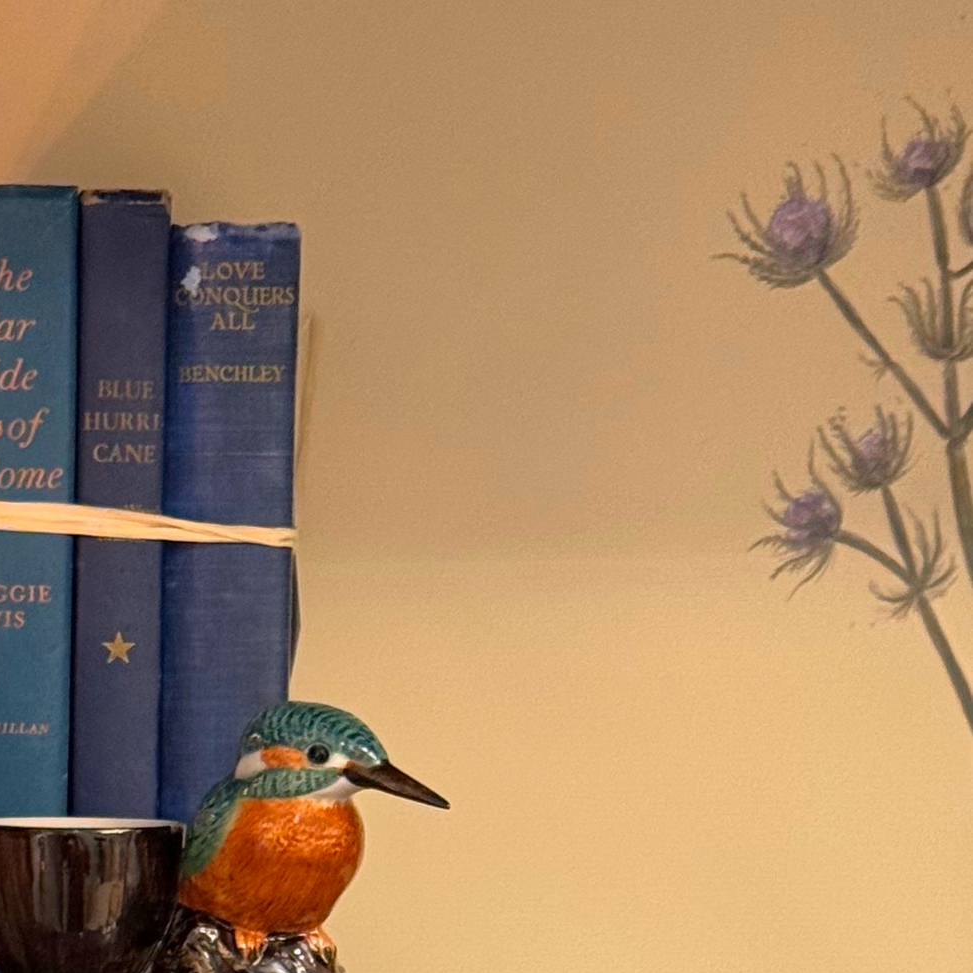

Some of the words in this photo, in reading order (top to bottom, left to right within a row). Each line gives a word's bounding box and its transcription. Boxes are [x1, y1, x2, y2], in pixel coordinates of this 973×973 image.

[200, 261, 266, 281] LOVE
[176, 286, 295, 313] CONQUERS
[209, 313, 256, 331] ALL
[179, 364, 286, 383] BENCHLEY
[98, 380, 155, 399] BLUE
[7, 406, 51, 449] of
[92, 443, 157, 463] CANE
